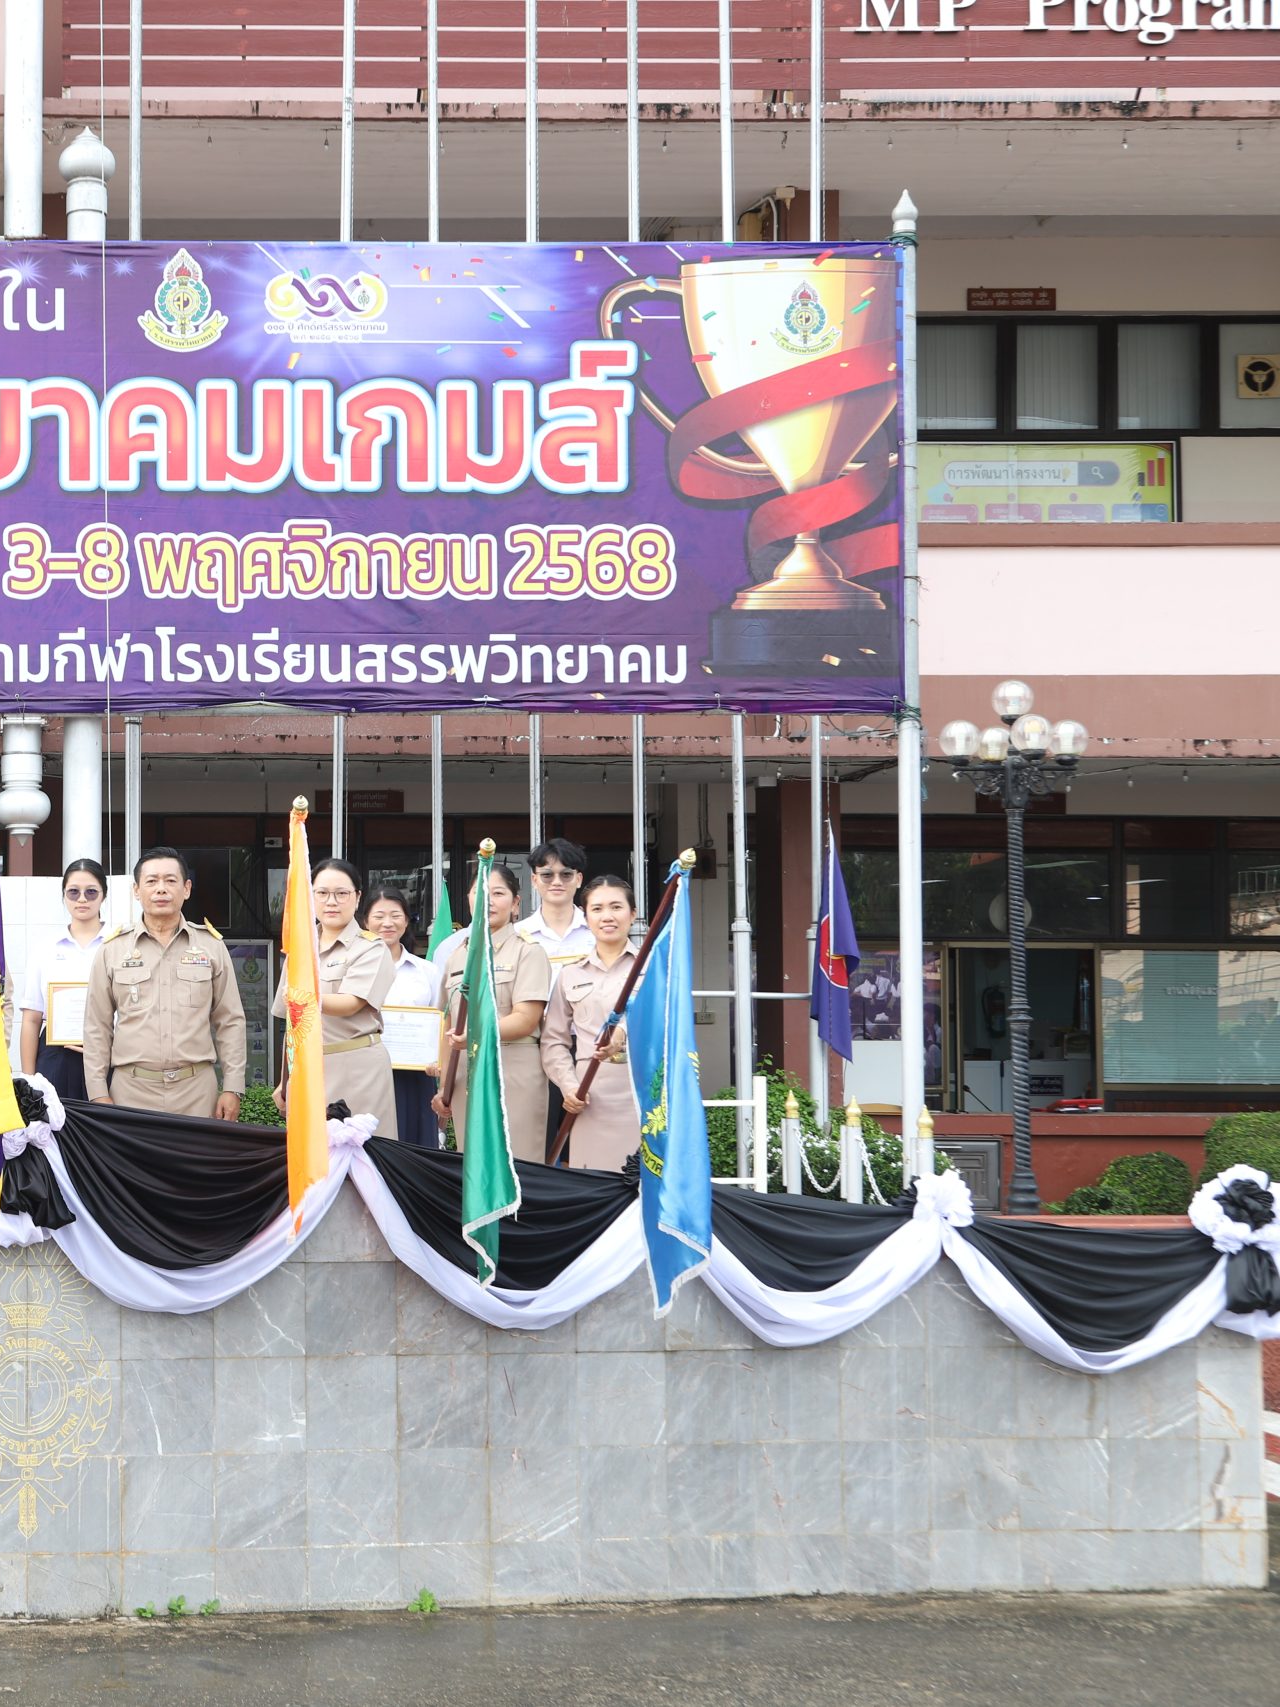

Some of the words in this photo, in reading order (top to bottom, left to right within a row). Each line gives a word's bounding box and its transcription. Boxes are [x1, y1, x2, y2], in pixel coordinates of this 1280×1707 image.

[948, 462, 1062, 481] การพัฒนาโครงงาน
[139, 518, 498, 613] พฤศจิกายน
[503, 521, 678, 602] 2568
